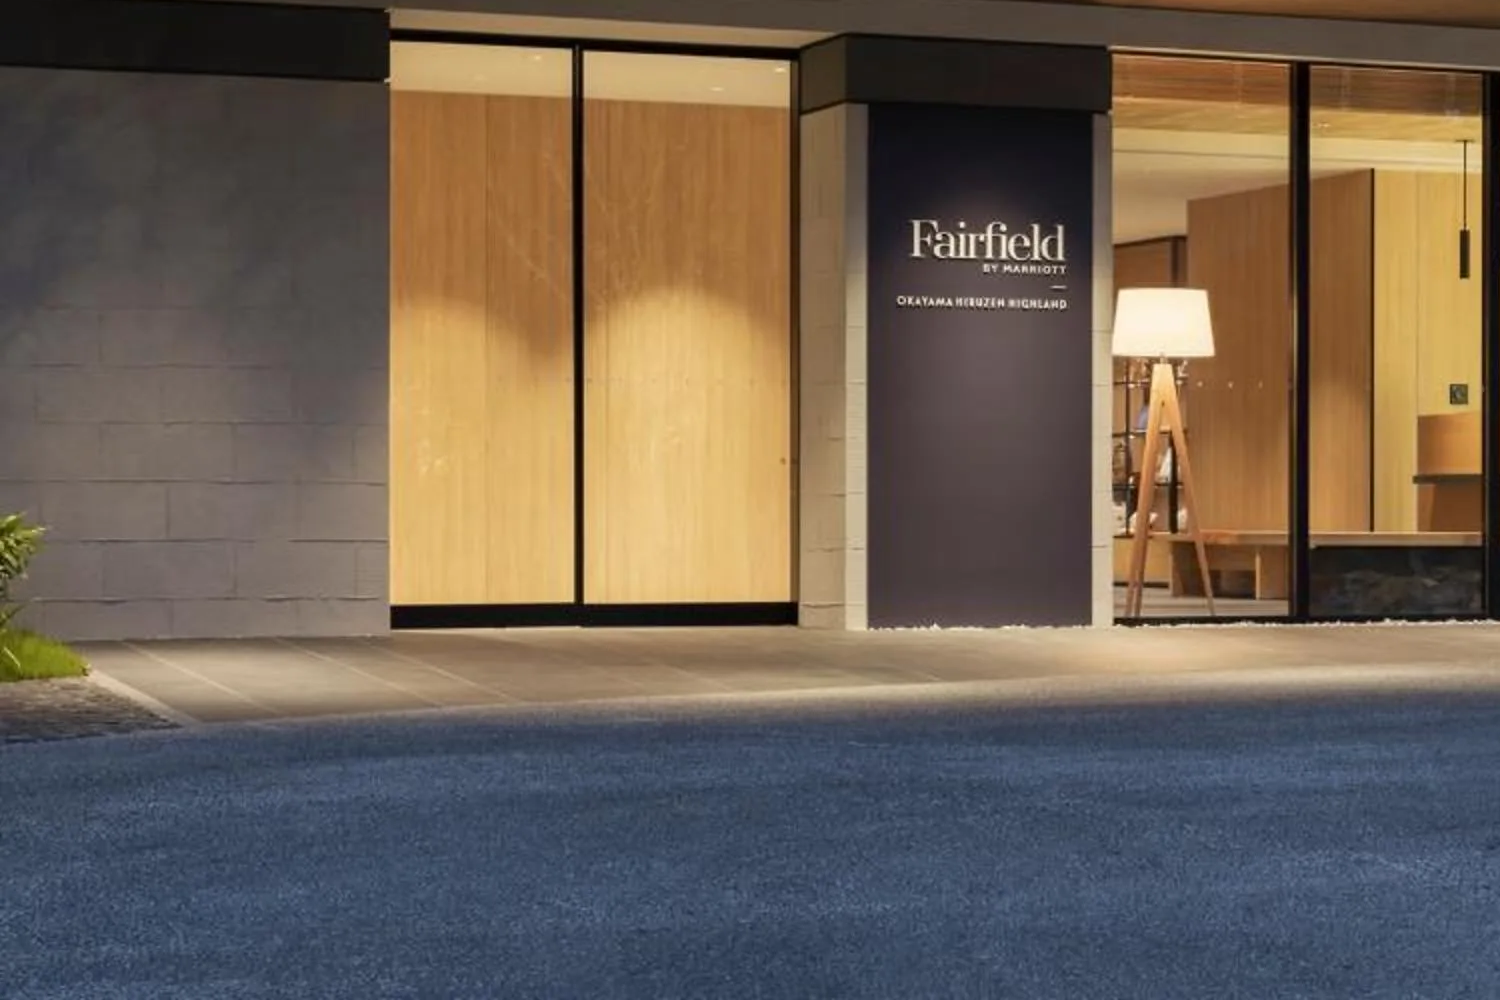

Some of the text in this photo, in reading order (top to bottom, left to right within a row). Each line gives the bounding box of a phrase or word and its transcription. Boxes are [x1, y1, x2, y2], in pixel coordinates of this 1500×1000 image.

[909, 218, 1066, 261] Fairfield
[982, 264, 1067, 275] BY MARRIOTT
[896, 295, 953, 307] OKAYAMA
